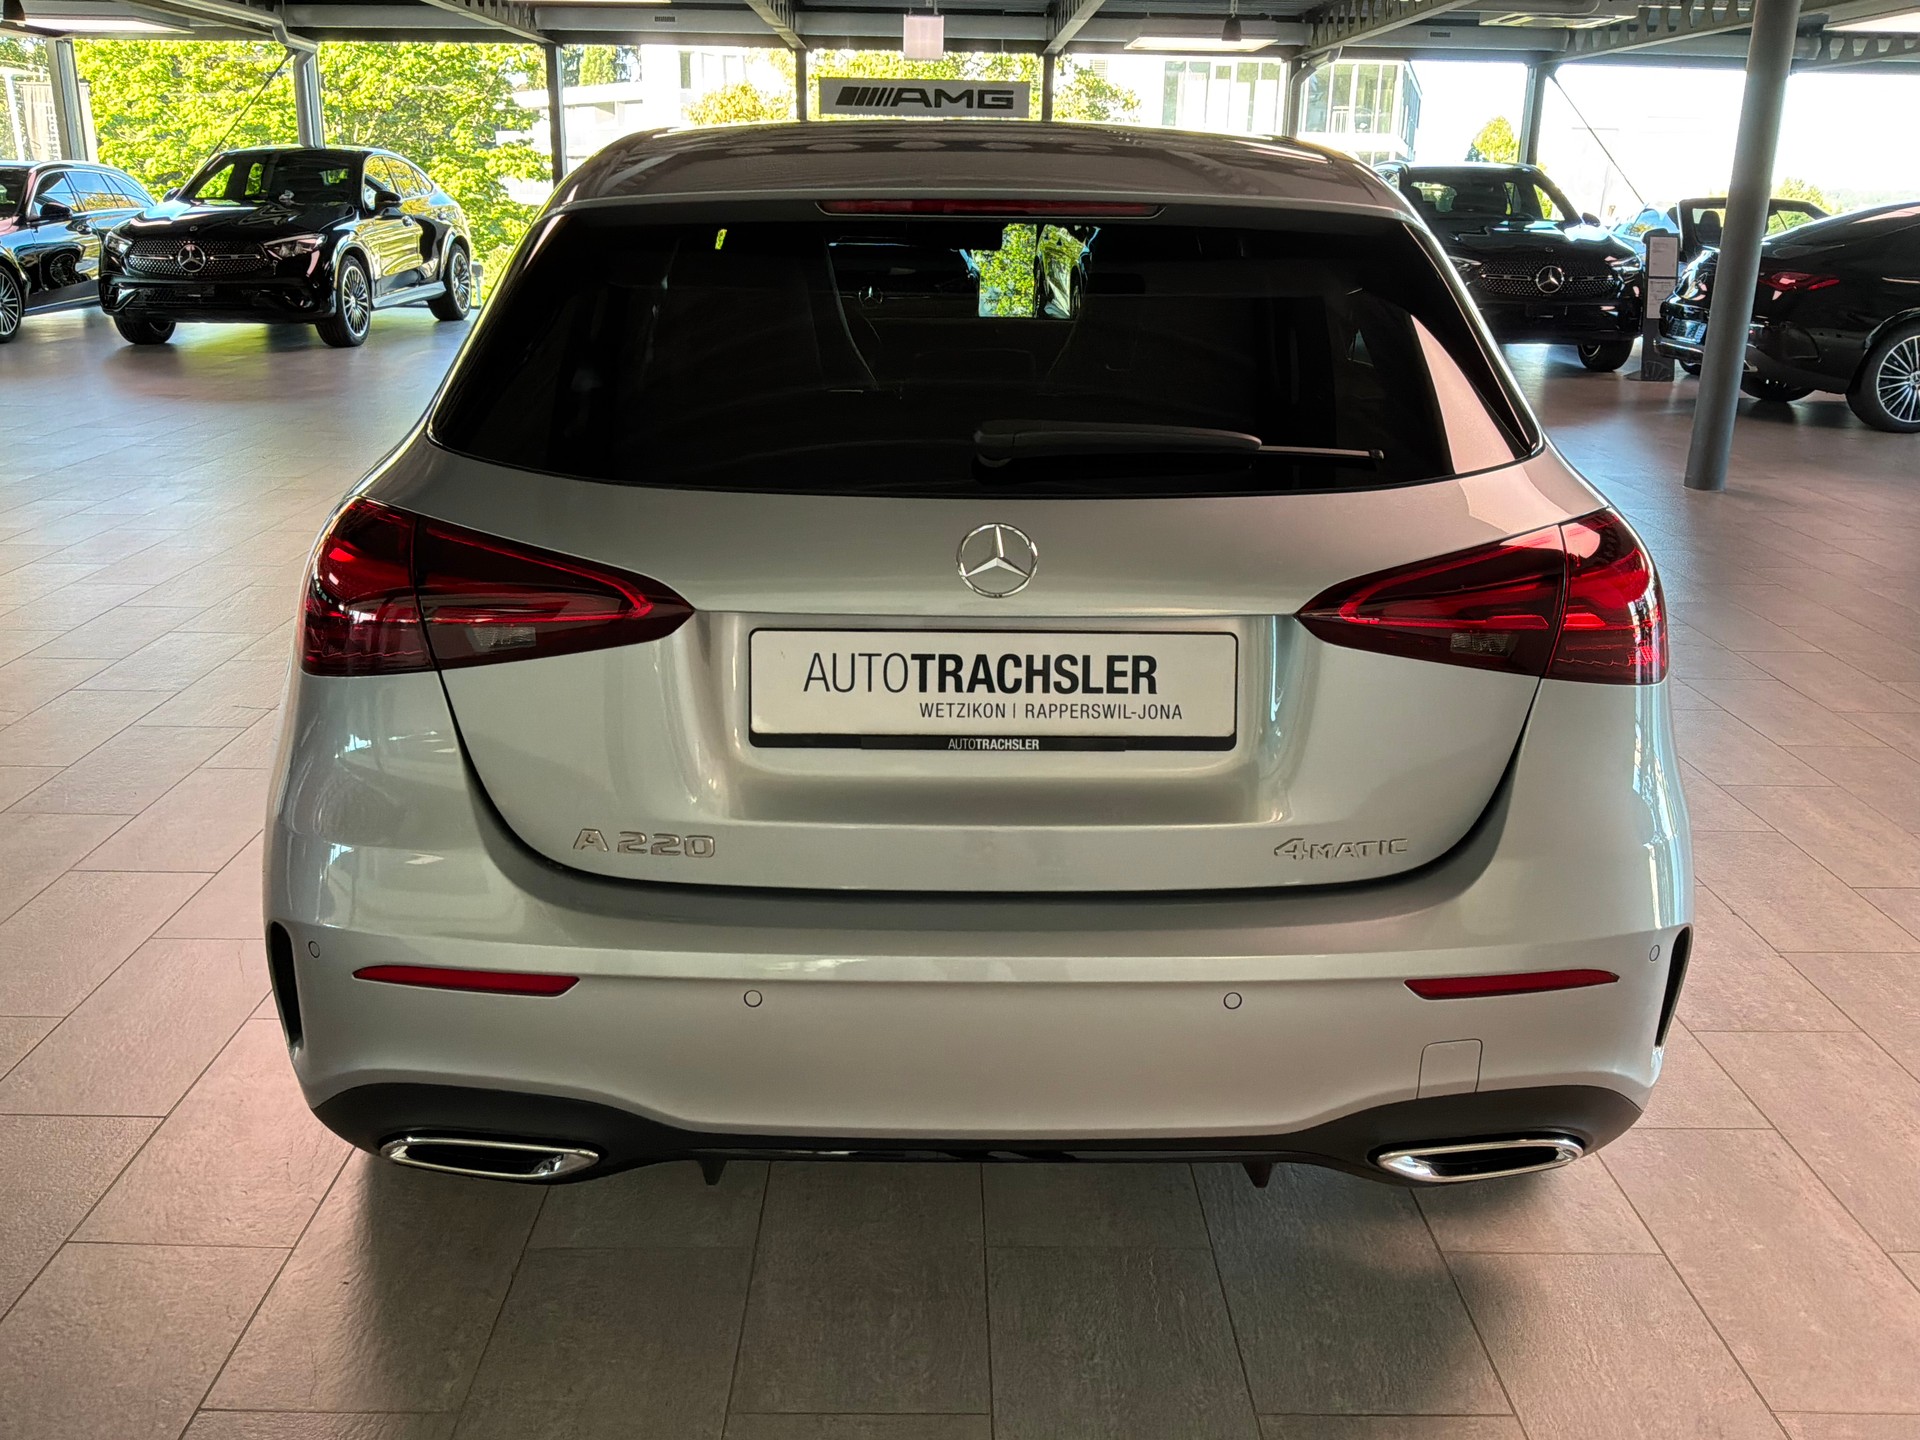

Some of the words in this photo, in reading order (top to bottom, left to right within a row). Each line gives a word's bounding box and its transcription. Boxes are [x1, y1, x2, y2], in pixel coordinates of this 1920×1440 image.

[803, 651, 1158, 695] AUTOTRACHSLER
[919, 702, 1006, 719] WETZIKON
[1025, 702, 1183, 721] RAPPERSWIL-JONA
[947, 737, 1040, 751] AUTOTRACHSLER
[573, 828, 609, 852] A
[617, 831, 715, 858] 220
[1274, 837, 1408, 860] 4MATIC
